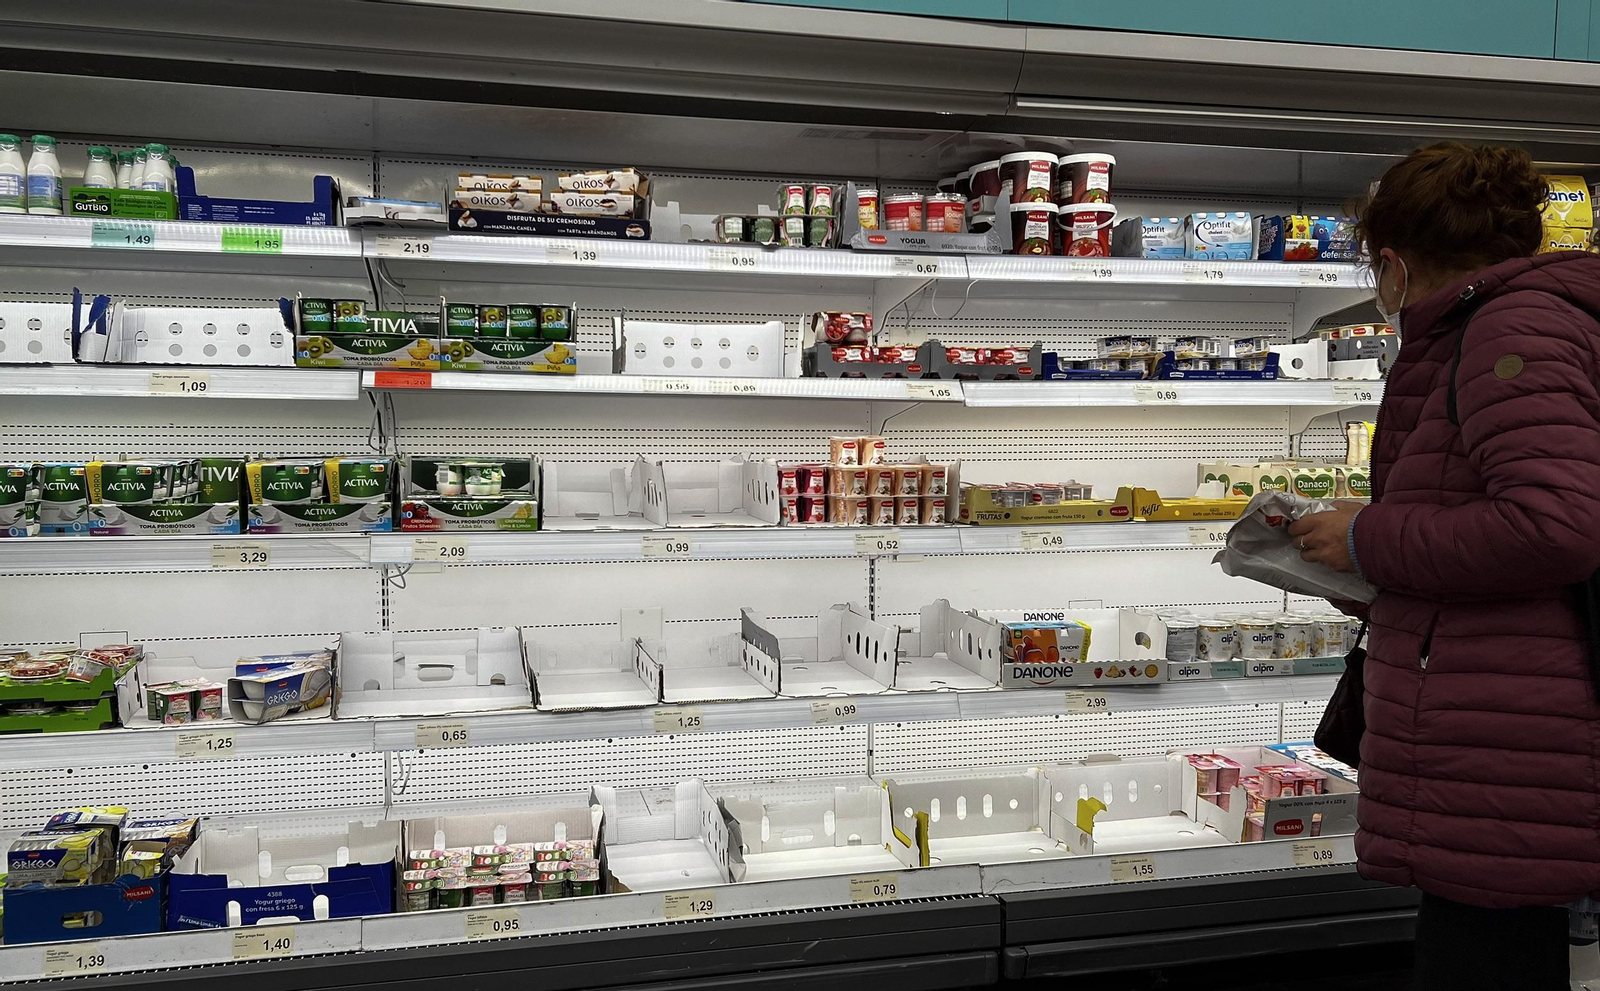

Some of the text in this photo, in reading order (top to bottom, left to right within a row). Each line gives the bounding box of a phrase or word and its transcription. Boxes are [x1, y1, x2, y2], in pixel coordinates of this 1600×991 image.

[572, 178, 604, 190] OIKOS
[471, 196, 507, 206] OIKOS
[1549, 189, 1585, 203] anet
[75, 202, 109, 213] GUTBIO
[566, 198, 600, 208] OIKOS
[507, 215, 536, 223] DISFRUTA
[556, 218, 596, 226] CREMOSIDAD
[1203, 220, 1231, 233] Optifit
[125, 235, 151, 245] 1,49
[254, 239, 279, 249] 1,95
[900, 237, 927, 245] YOGUR
[403, 242, 430, 254] 2,19
[572, 250, 597, 261] 1,39
[731, 256, 755, 266] 0,95
[916, 264, 938, 274] 0,67
[1092, 269, 1113, 280] 1,99
[1203, 269, 1225, 281] 1,79
[1318, 272, 1338, 284] 4,99
[351, 338, 388, 348] ACTIVIA
[491, 344, 526, 352] ACTIVIA
[410, 360, 426, 368] Piña
[546, 364, 561, 372] Piña
[179, 381, 207, 394] 1,09
[928, 389, 952, 399] 1,05
[1156, 391, 1178, 402] 0,69
[1353, 391, 1372, 402] 1,99
[44, 482, 80, 491] ACTIVIA
[107, 482, 147, 491] ACTIVIA
[266, 481, 304, 490] ACTIVIA
[344, 478, 380, 488] ACTIVIA
[1298, 479, 1330, 489] Danacol
[1350, 479, 1371, 488] Dana
[304, 507, 337, 516] ACTIVIA
[451, 503, 484, 512] ACTIVIA
[1140, 503, 1160, 516] Kéfir
[149, 509, 184, 518] ACTIVIA
[976, 512, 1003, 521] FRUTAS
[157, 523, 196, 531] PROBIÓTICOS
[877, 540, 900, 550] 0,52
[1042, 536, 1063, 546] 0,49
[439, 546, 466, 558] 2,09
[666, 543, 689, 554] 0,99
[239, 551, 268, 565] 3,29
[1252, 632, 1273, 645] alpro
[1178, 665, 1201, 678] alpro
[1252, 662, 1275, 674] alpro
[267, 690, 298, 706] GRIEGO
[1086, 697, 1107, 711] 2,99
[835, 703, 857, 717] 0,99
[677, 716, 701, 729] 1,25
[442, 730, 468, 744] 0,65
[206, 737, 233, 754] 1,25
[1276, 823, 1302, 832] MILSANI
[1313, 850, 1334, 861] 0,89
[12, 860, 56, 870] GRIEGO
[1132, 864, 1154, 876] 1,55
[126, 889, 152, 898] MILSANI
[873, 884, 896, 898] 0,79
[689, 899, 713, 915] 1,29
[493, 919, 519, 933] 0,95
[262, 937, 292, 953] 1,40
[76, 954, 106, 969] 1,39
